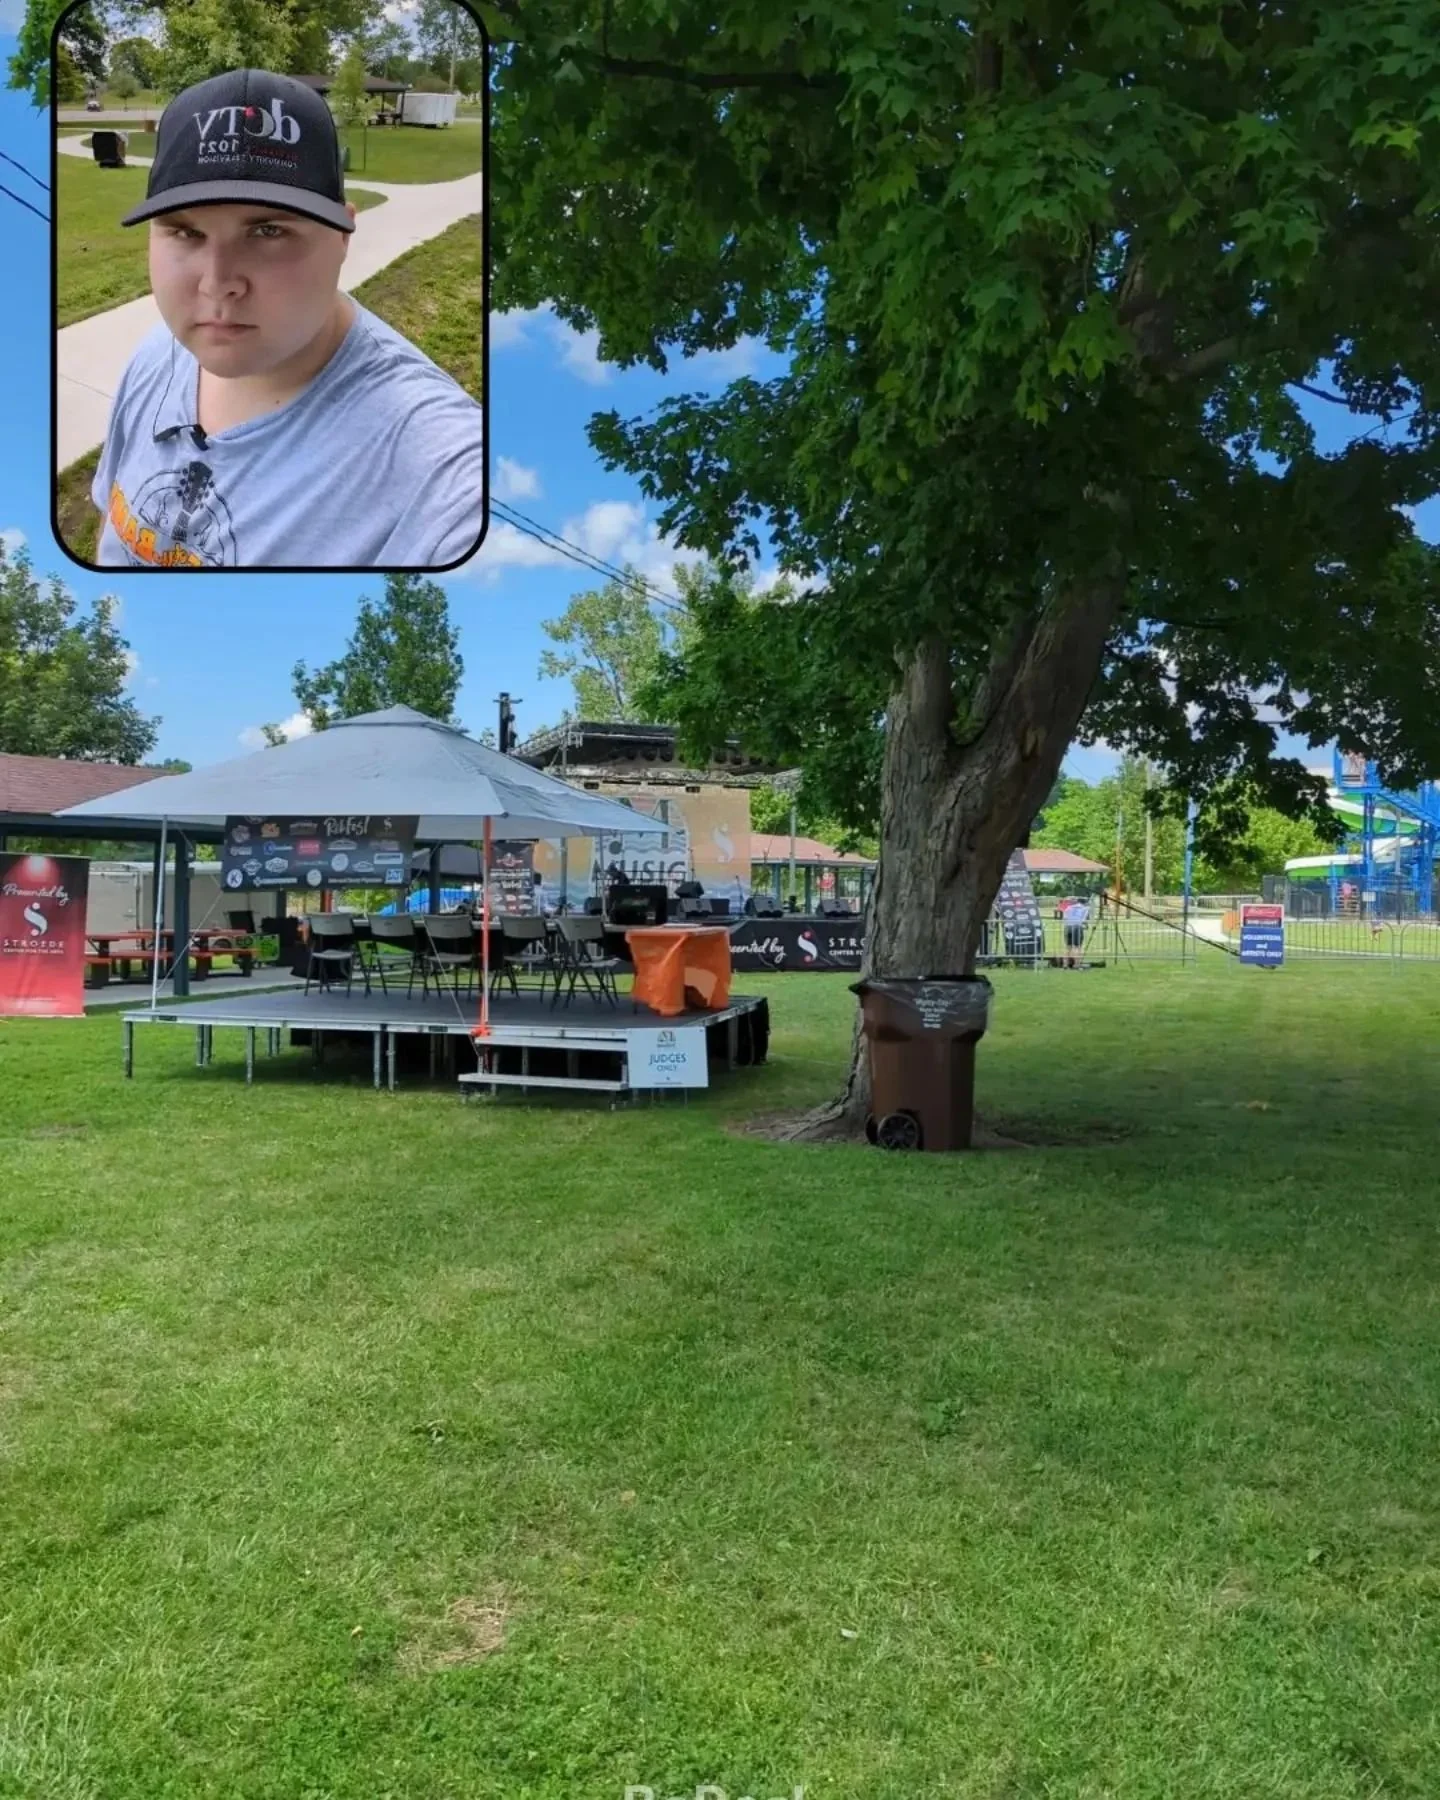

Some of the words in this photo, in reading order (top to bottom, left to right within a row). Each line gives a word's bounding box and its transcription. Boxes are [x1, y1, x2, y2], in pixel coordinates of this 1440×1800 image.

[3, 883, 57, 898] Presented
[55, 885, 70, 906] by
[770, 937, 787, 963] by
[649, 1053, 687, 1065] JUDGES
